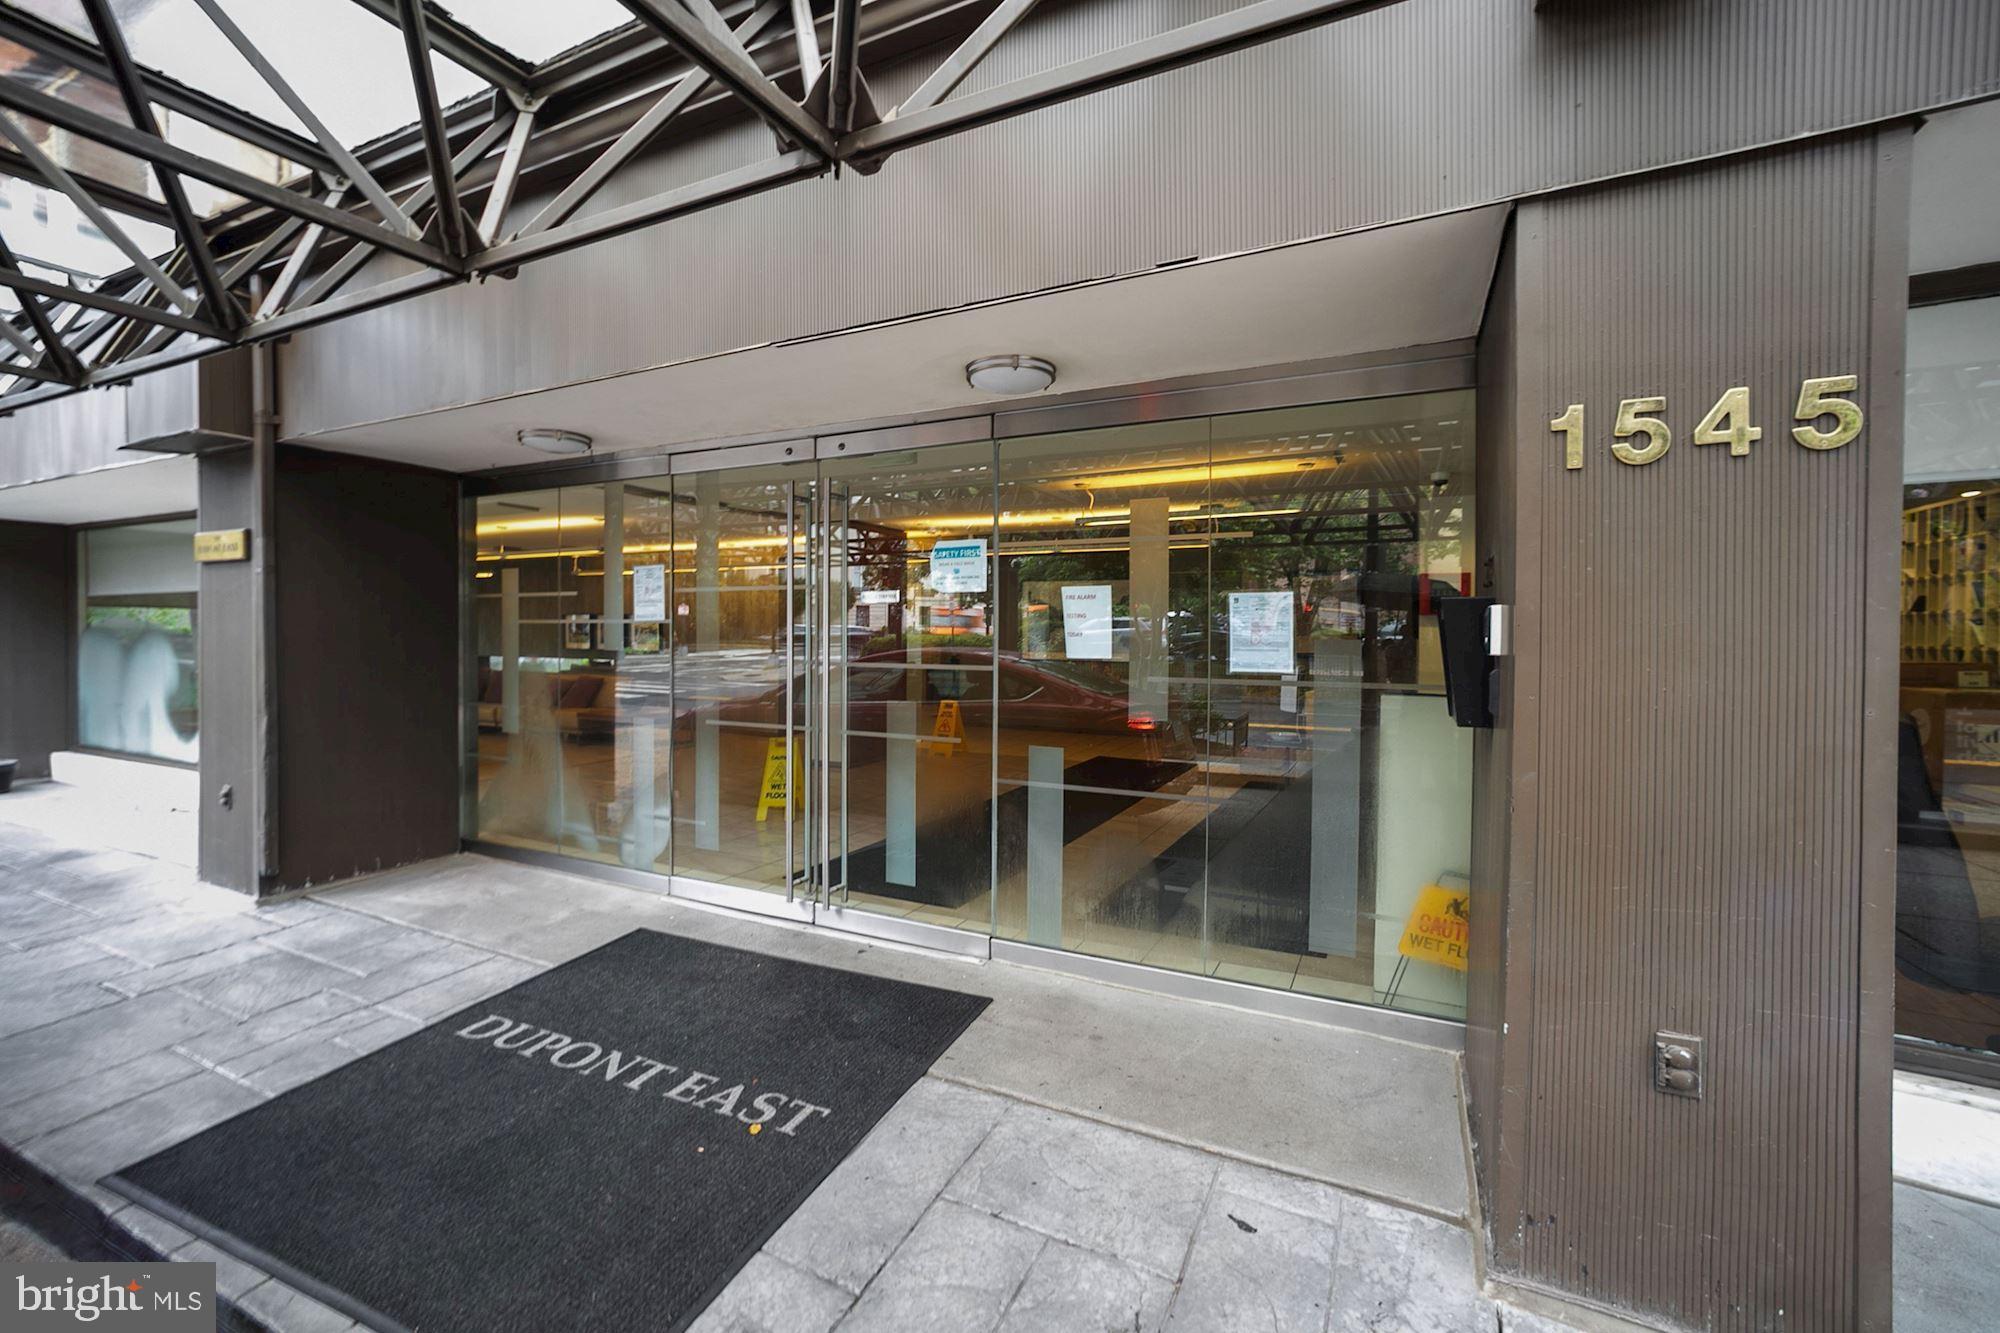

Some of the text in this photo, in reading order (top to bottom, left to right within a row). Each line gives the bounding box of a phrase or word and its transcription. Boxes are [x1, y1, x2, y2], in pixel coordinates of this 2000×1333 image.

[1550, 375, 1864, 469] 1545
[1409, 933, 1444, 952] WET
[456, 1014, 831, 1136] DUPONT EAST
